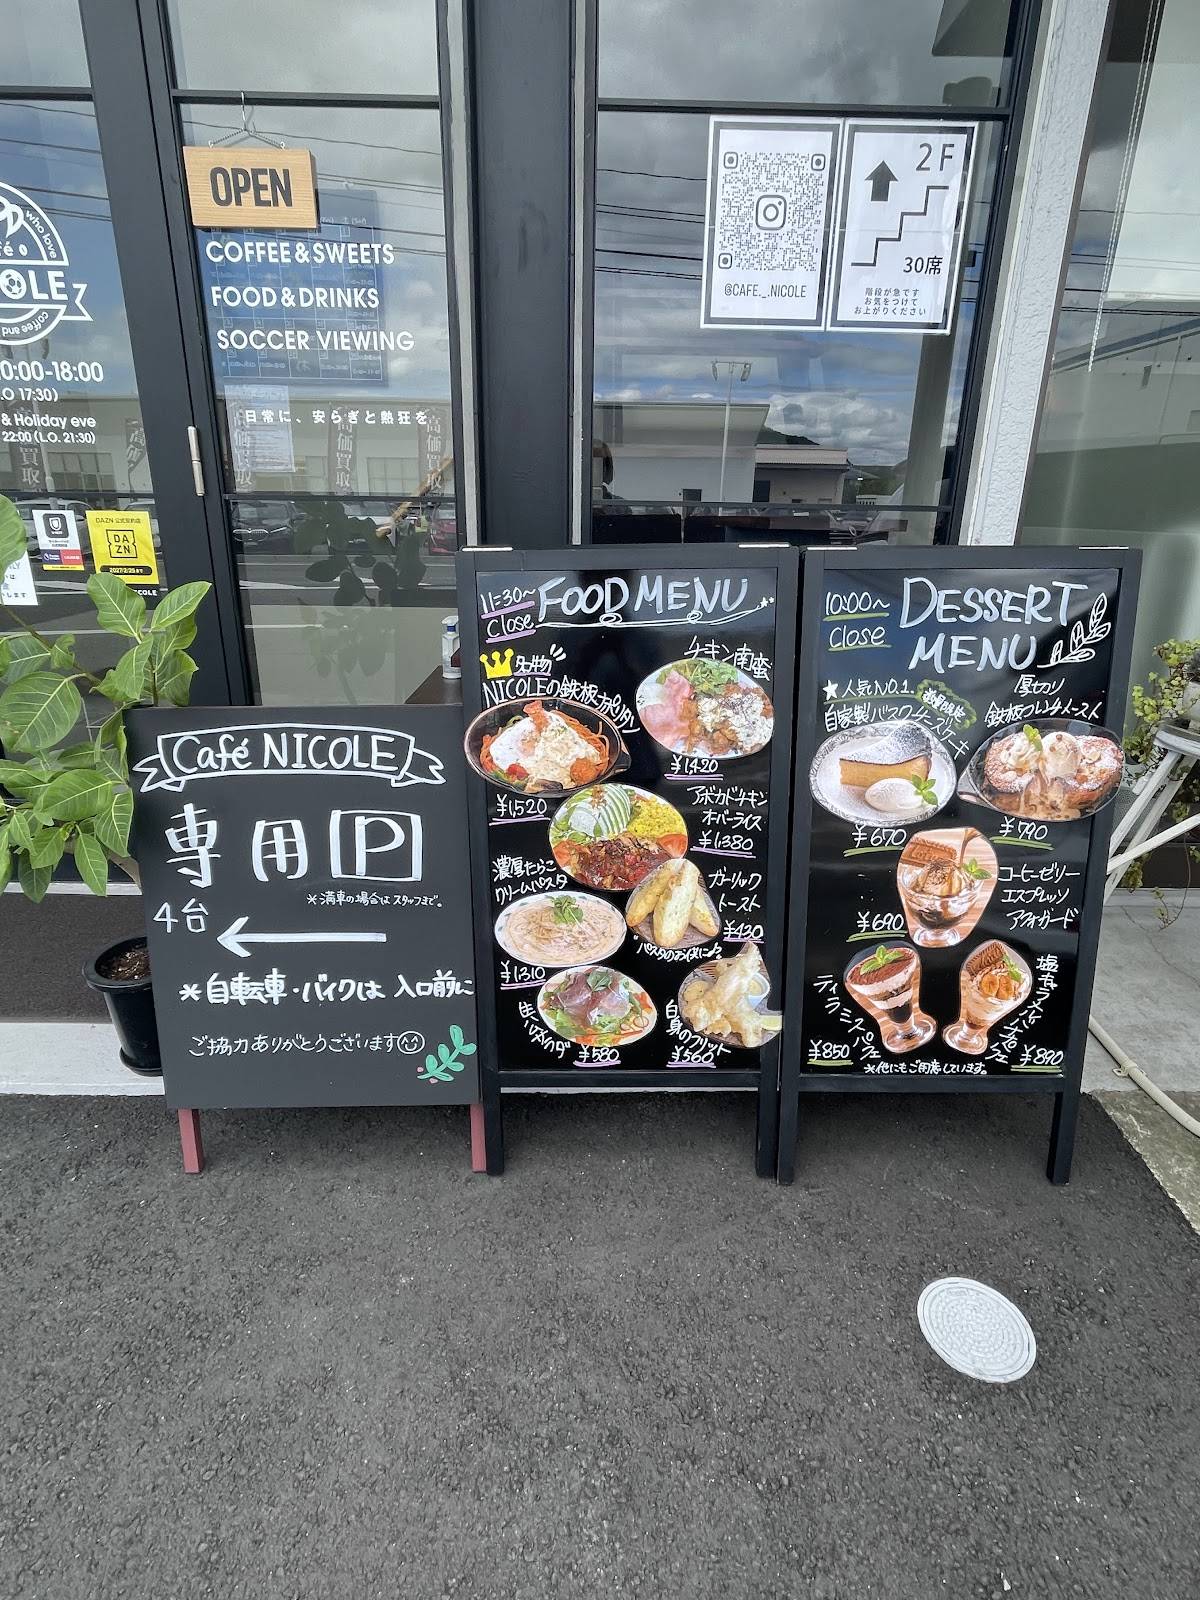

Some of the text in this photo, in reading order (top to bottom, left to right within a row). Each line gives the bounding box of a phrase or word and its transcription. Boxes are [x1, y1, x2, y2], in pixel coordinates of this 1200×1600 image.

[209, 167, 294, 208] OPEN
[25, 209, 58, 259] who love
[903, 256, 943, 276] 30席
[864, 298, 917, 307] お気をつけて
[865, 288, 919, 297] 階段が急です
[854, 307, 926, 316] お上がりください
[2, 311, 49, 337] coffee and
[216, 329, 415, 352] SOCCER VIEWING
[19, 387, 59, 402] 17:30)
[1, 413, 97, 430] & Holiday eve
[2, 431, 32, 443] 22:00
[62, 432, 96, 445] 21:30)
[538, 575, 748, 622] FOOD MENU
[899, 577, 1088, 629] DESSERT
[515, 654, 552, 675] 名物
[684, 635, 772, 681] チキン南蛮
[908, 633, 1036, 673] MENU
[1014, 674, 1066, 697] 厚切り
[984, 697, 1103, 729] 鉄板フレンチトースト
[824, 702, 970, 760] 自家製バスクチーズケーキ
[173, 733, 399, 774] Café NICOLE
[670, 754, 719, 775] ¥1,420
[496, 793, 547, 818] ¥1,520
[687, 785, 768, 808] アボカドチキン
[702, 808, 762, 832] オーバーライス
[1000, 816, 1048, 840] ¥790
[851, 824, 907, 847] ¥670
[492, 855, 557, 882] 濃厚たらこ
[708, 865, 762, 891] ガーリック
[998, 862, 1081, 883] コーヒーゼリー
[495, 873, 568, 905] クリームパスタ
[1001, 886, 1070, 905] エスプレッソ
[719, 893, 761, 912] トースト
[153, 898, 209, 934] 4台
[857, 911, 904, 933] ¥690
[1006, 907, 1079, 930] アフォガード
[665, 999, 731, 1056] 白身のフリット
[813, 974, 881, 1061] ティラミスパフェ
[578, 1043, 620, 1063] ¥580
[671, 1045, 714, 1063] ¥560
[808, 1040, 850, 1060] ¥850
[1020, 1044, 1064, 1067] ¥890
